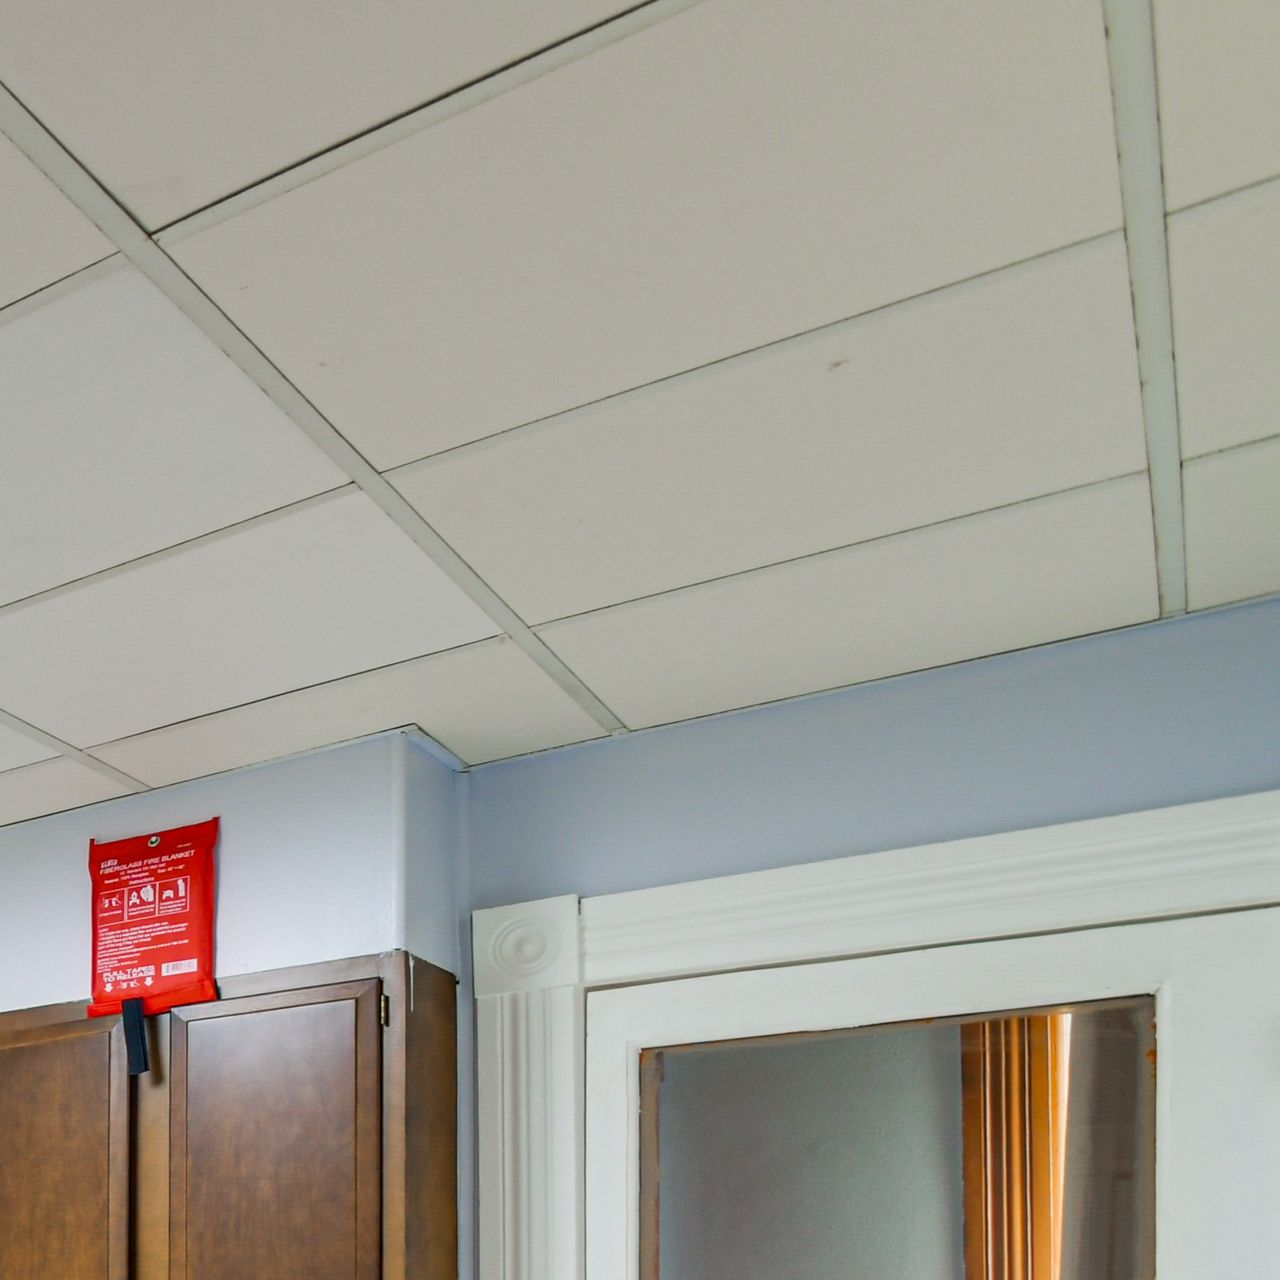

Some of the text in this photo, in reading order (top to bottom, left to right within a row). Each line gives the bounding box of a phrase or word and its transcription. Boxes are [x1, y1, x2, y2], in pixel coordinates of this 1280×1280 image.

[100, 860, 142, 875] FIBERGLASS
[143, 857, 160, 866] FIRE
[161, 850, 195, 862] BLANKET
[103, 965, 155, 979] PULL TAPES
[103, 971, 155, 983] TO RELEASE
